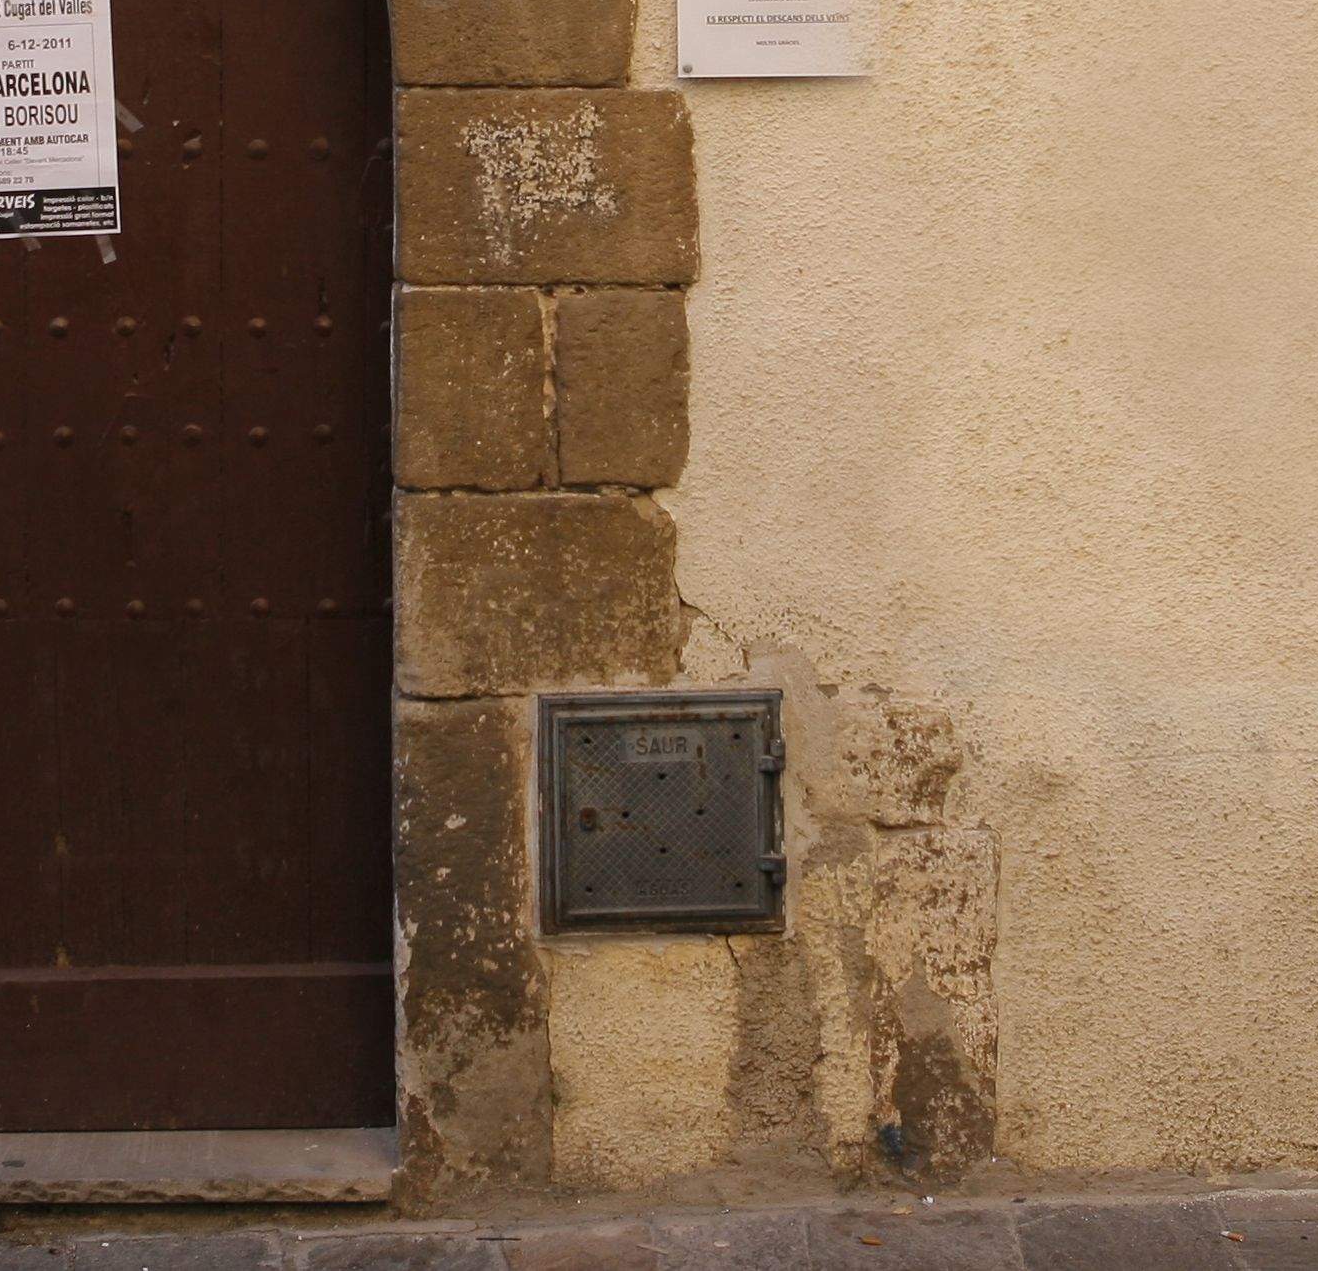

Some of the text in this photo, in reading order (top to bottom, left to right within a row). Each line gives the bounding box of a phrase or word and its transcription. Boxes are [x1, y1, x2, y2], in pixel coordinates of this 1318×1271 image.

[4, 0, 36, 20] Cugat
[718, 15, 755, 24] RESPECTI
[767, 14, 804, 23] DESCANS
[1, 59, 35, 70] PARTIT
[4, 103, 78, 127] BORISOU
[24, 135, 44, 146] AMB
[46, 134, 89, 145] AUTOCAR
[1, 146, 28, 156] 18:45
[635, 736, 687, 755] SAUR
